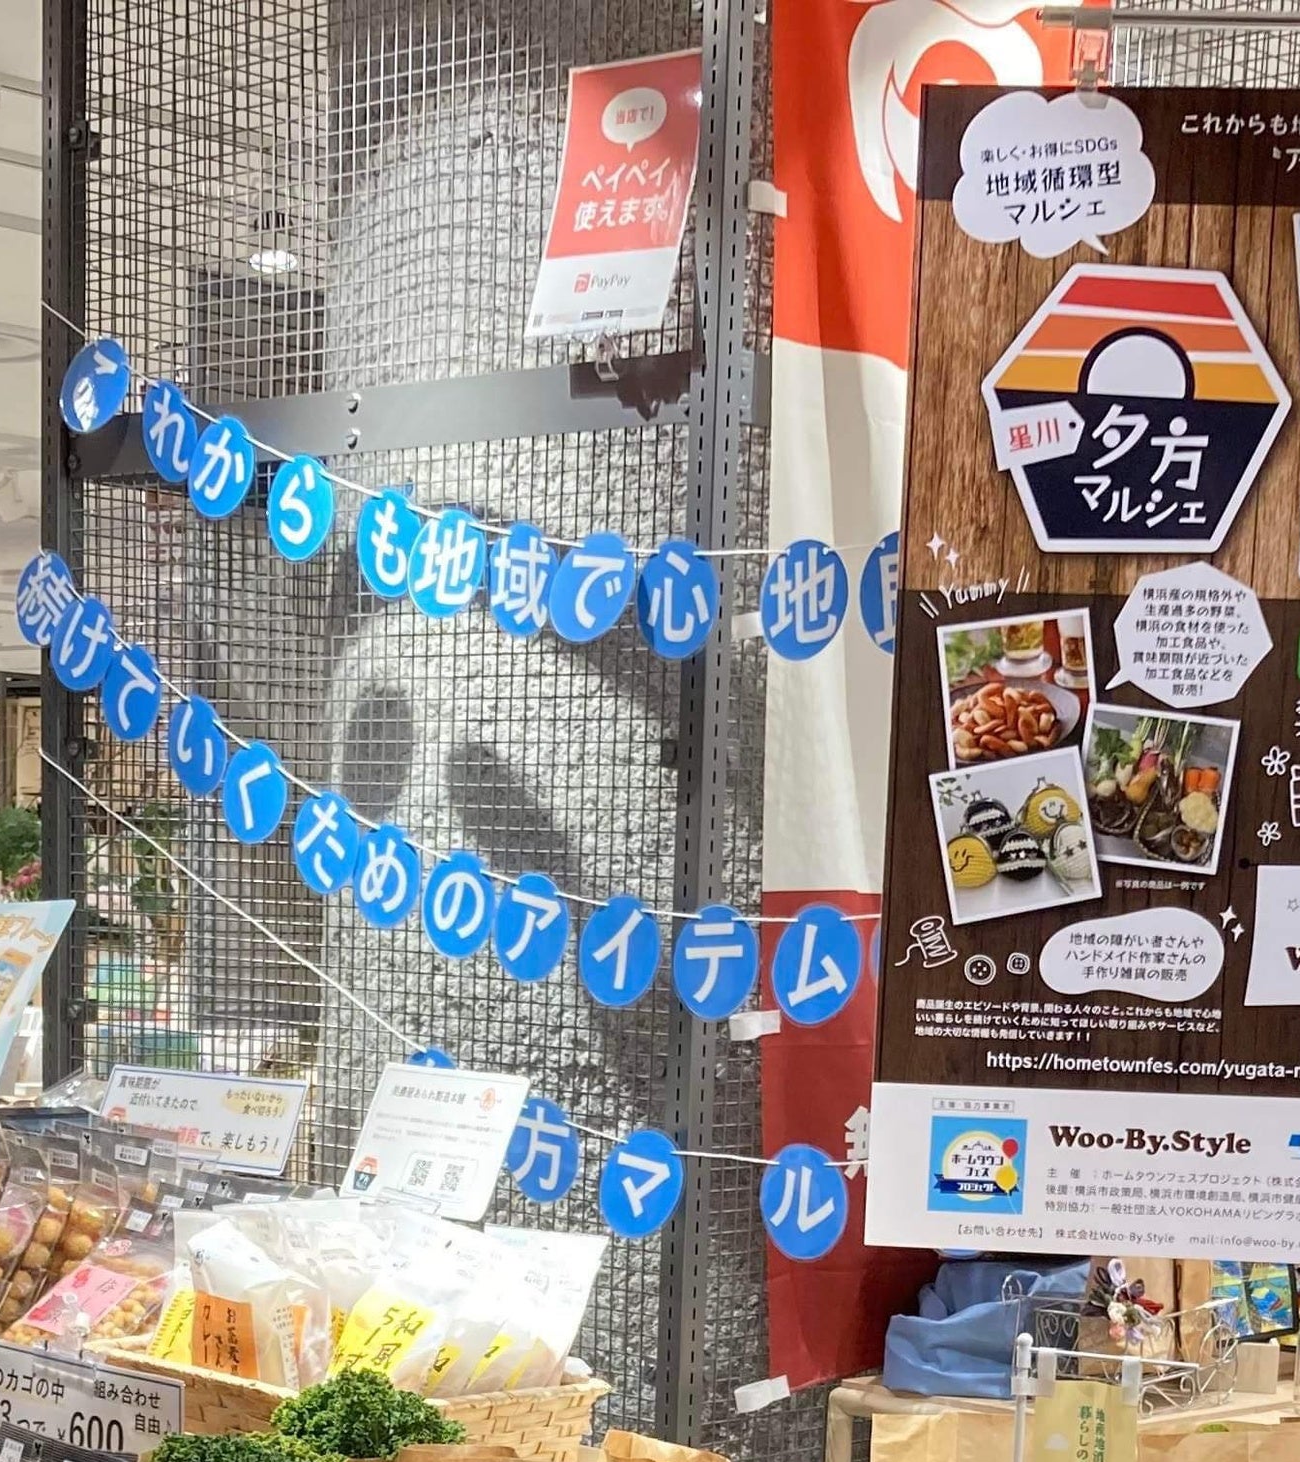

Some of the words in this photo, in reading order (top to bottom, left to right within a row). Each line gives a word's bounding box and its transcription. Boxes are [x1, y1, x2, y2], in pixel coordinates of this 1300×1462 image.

[581, 156, 672, 194] ペイペイ
[985, 161, 1122, 197] 地域循環型
[1003, 194, 1108, 227] マルシェ
[590, 273, 632, 291] PayPay
[1007, 417, 1062, 452] 星川
[1091, 404, 1212, 493] 夕方
[1073, 471, 1209, 528] マルシェ
[939, 577, 1010, 610] Yummy
[1048, 1124, 1252, 1159] Woo-By.Style
[93, 1379, 161, 1410] 組み合わせ
